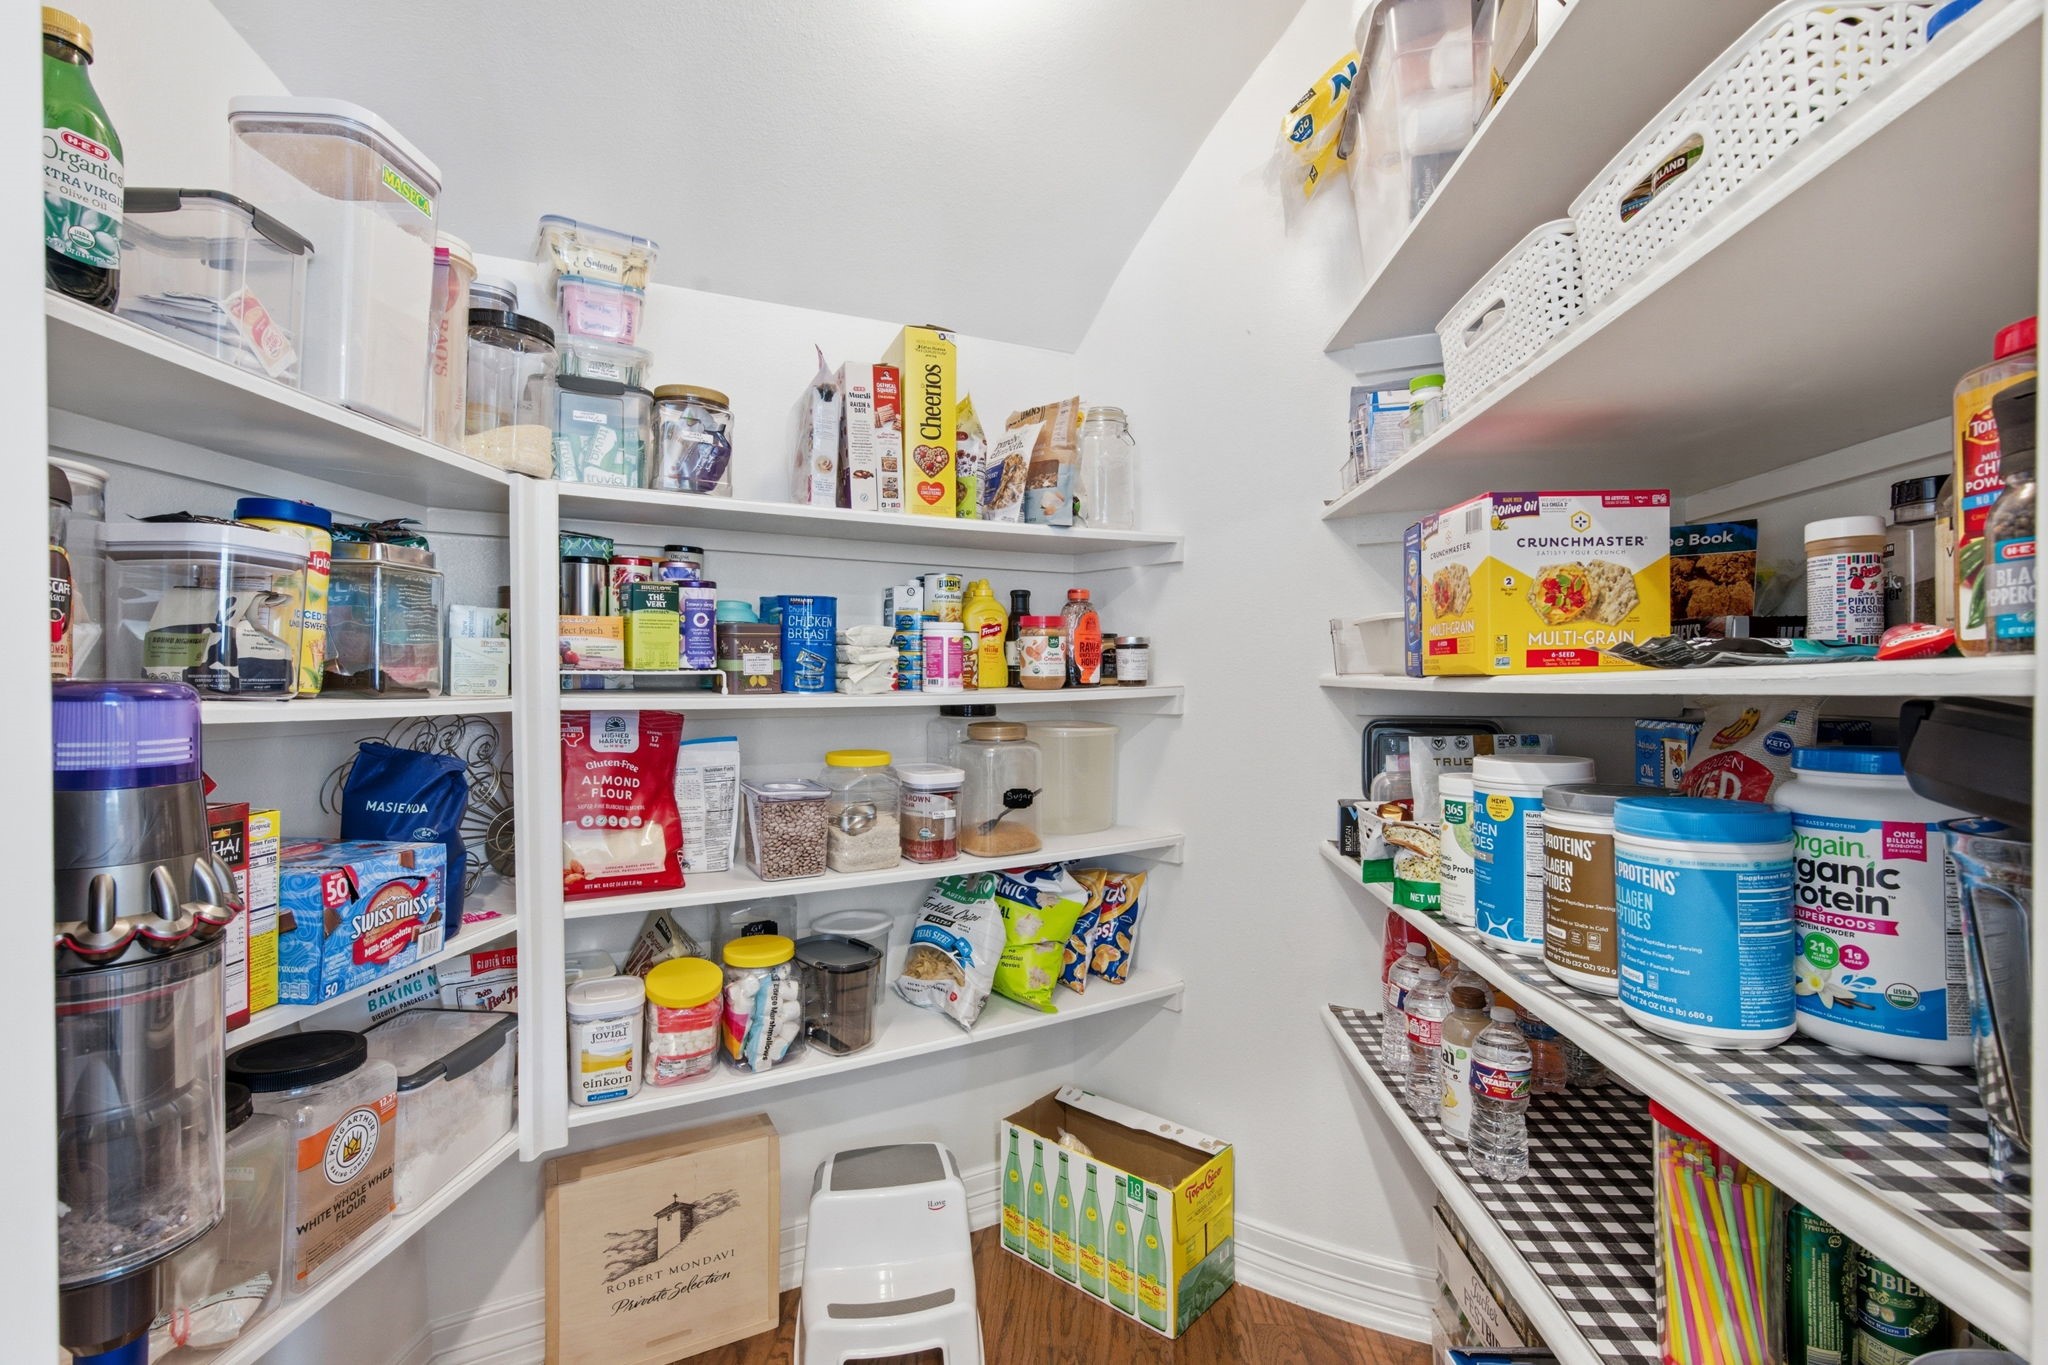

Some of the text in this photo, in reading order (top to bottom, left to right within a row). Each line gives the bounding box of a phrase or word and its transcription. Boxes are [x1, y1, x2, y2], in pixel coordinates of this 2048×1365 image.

[43, 135, 123, 189] Organics
[44, 165, 82, 189] XTRA
[60, 185, 107, 212] Olive Oil
[383, 166, 431, 218] MASECA
[919, 363, 942, 441] Cheerios
[1974, 463, 2000, 478] CHI
[1498, 501, 1538, 517] Olive Oil
[1516, 535, 1645, 549] CRUNCHMASTER
[1689, 531, 1734, 546] Book
[1430, 541, 1471, 560] CRUNCHMASTER
[1847, 596, 1875, 606] PINTO
[788, 615, 833, 628] CHICKEN
[1429, 618, 1475, 637] MULTI-GRAIN
[579, 626, 604, 636] Peach
[787, 628, 830, 640] BREAST
[1527, 629, 1635, 646] MULTI-GRAIN
[598, 738, 632, 746] HARVEST
[600, 732, 630, 740] HIGHER
[650, 735, 660, 744] 17
[1765, 738, 1791, 749] KETO
[585, 758, 640, 774] Gluten-Free
[1432, 757, 1473, 767] TRUE
[581, 775, 641, 789] ALMOND
[590, 788, 633, 800] FLOUR
[1006, 792, 1032, 802] Sugar
[365, 799, 429, 815] MASIENDA
[1444, 803, 1464, 817] 365
[1885, 836, 1923, 846] BILLION
[1892, 830, 1916, 839] ONE
[1545, 832, 1593, 862] PROTEINS
[266, 855, 277, 865] 150
[1452, 865, 1474, 876] Prote
[1793, 860, 1901, 892] rganic
[1618, 862, 1676, 896] PROTEINS
[326, 877, 349, 902] 50
[1409, 891, 1425, 903] NET
[922, 895, 955, 917] Tortilla
[1793, 884, 1890, 917] rotein
[350, 892, 429, 940] SWISS MISS
[1819, 925, 1856, 939] POWDER
[364, 926, 412, 958] Milk Chocolate
[1678, 943, 1703, 955] Serving
[1809, 939, 1834, 956] 21g
[1557, 947, 1590, 962] Supplement
[1844, 948, 1862, 962] 1g
[476, 957, 501, 970] GLUTEN
[324, 981, 339, 999] 50
[367, 979, 423, 1013] BAKING
[1636, 984, 1678, 1004] Supplement
[1892, 988, 1914, 997] USDA
[399, 993, 429, 1011] PANCAKES
[485, 989, 507, 1011] Red
[1687, 1009, 1705, 1020] 680
[1705, 1013, 1714, 1023] g
[590, 1026, 628, 1045] jovial
[762, 1005, 779, 1061] Marshmallows
[582, 1074, 633, 1089] einkorn
[328, 1113, 377, 1157] KING ARTHUR
[1129, 1180, 1142, 1197] 18
[1184, 1166, 1223, 1204] Topo Chico
[295, 1163, 394, 1237] WHITE WHOLE WHEA
[335, 1194, 367, 1224] FLOUR
[606, 1248, 736, 1295] ROBERT MONDAVI
[610, 1270, 731, 1318] Private Selection
